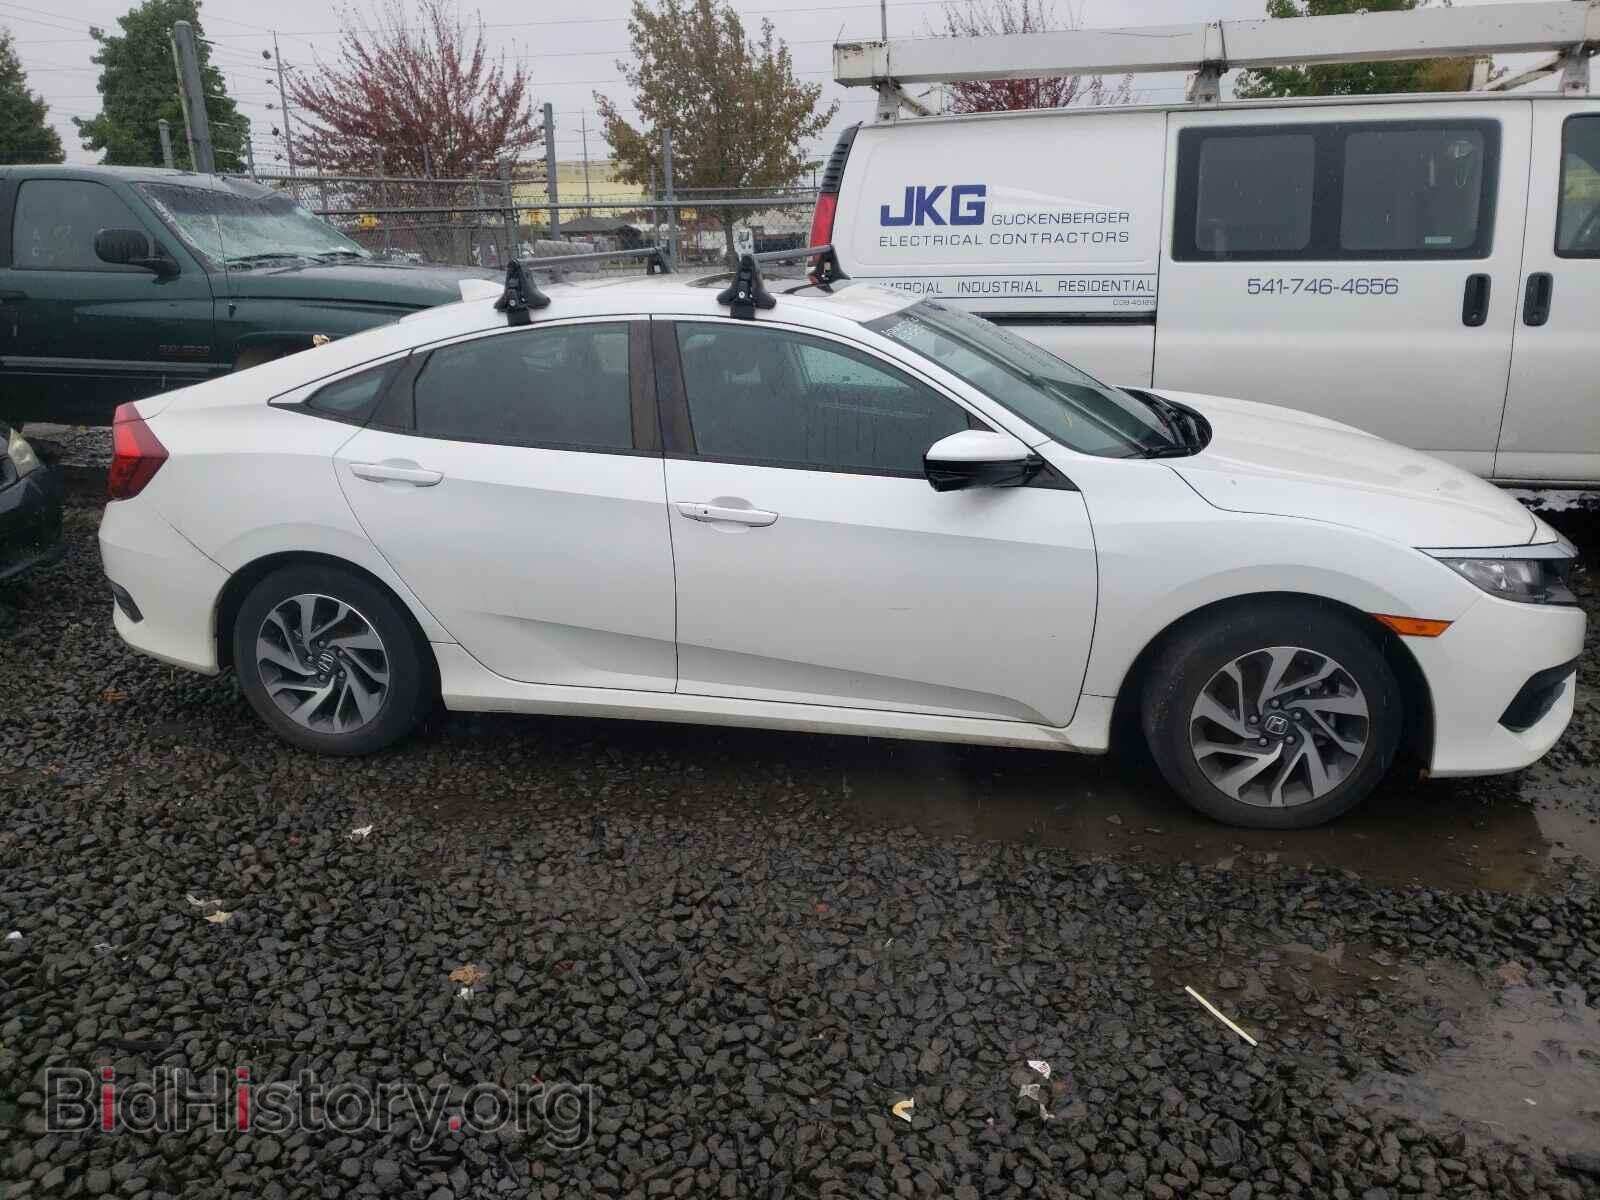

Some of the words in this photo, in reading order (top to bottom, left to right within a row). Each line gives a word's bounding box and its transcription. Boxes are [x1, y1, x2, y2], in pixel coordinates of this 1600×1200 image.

[880, 184, 986, 226] JKG
[991, 212, 1129, 226] GUCKENBERGER
[879, 232, 984, 247] ELECTRICAL
[989, 231, 1129, 245] CONTRACTORS
[957, 280, 1043, 293] INDUSTRIAL
[1058, 279, 1154, 292] RESIDENTIAL
[1247, 277, 1399, 295] 541-746-4656
